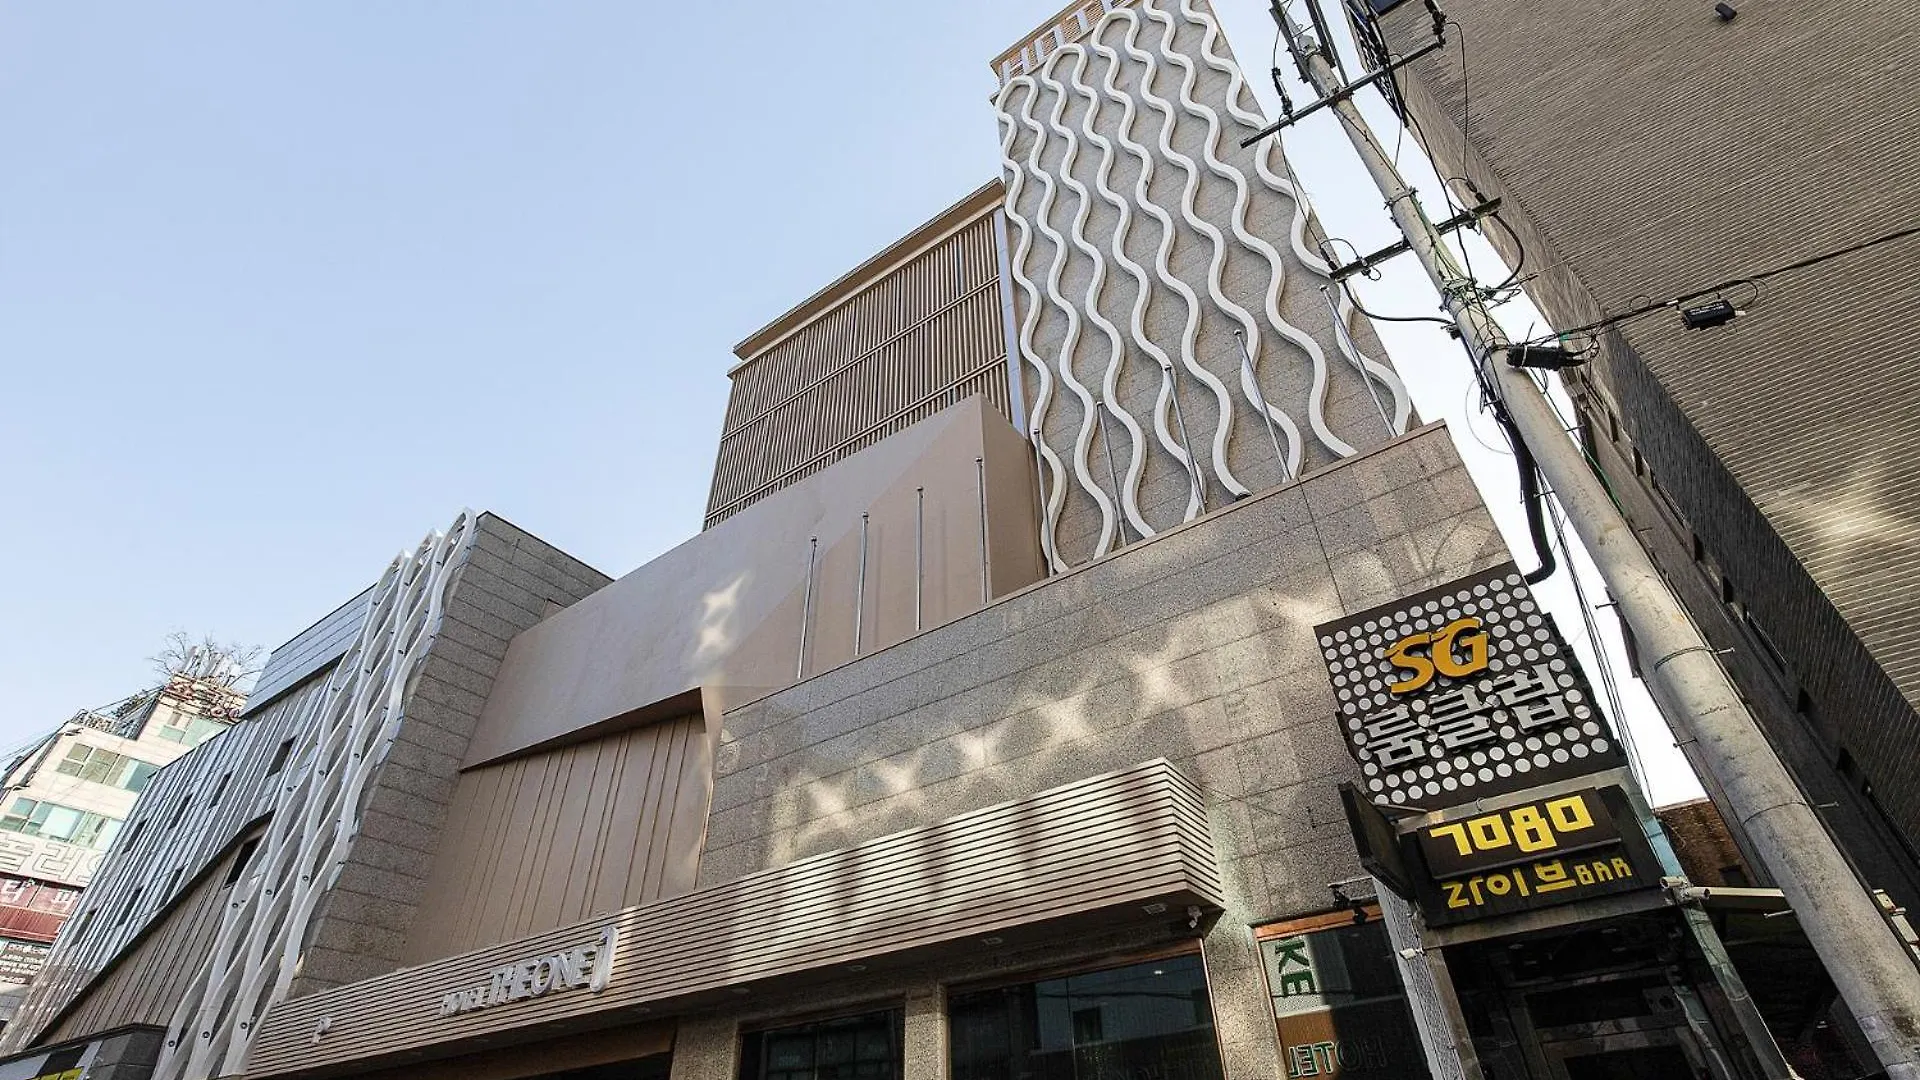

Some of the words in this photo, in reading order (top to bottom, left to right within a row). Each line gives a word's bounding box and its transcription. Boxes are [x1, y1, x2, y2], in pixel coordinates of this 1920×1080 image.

[1384, 617, 1489, 693] SG
[1364, 663, 1570, 768] 룸클럽
[1429, 795, 1595, 856] 7080
[1573, 857, 1633, 885] BAR
